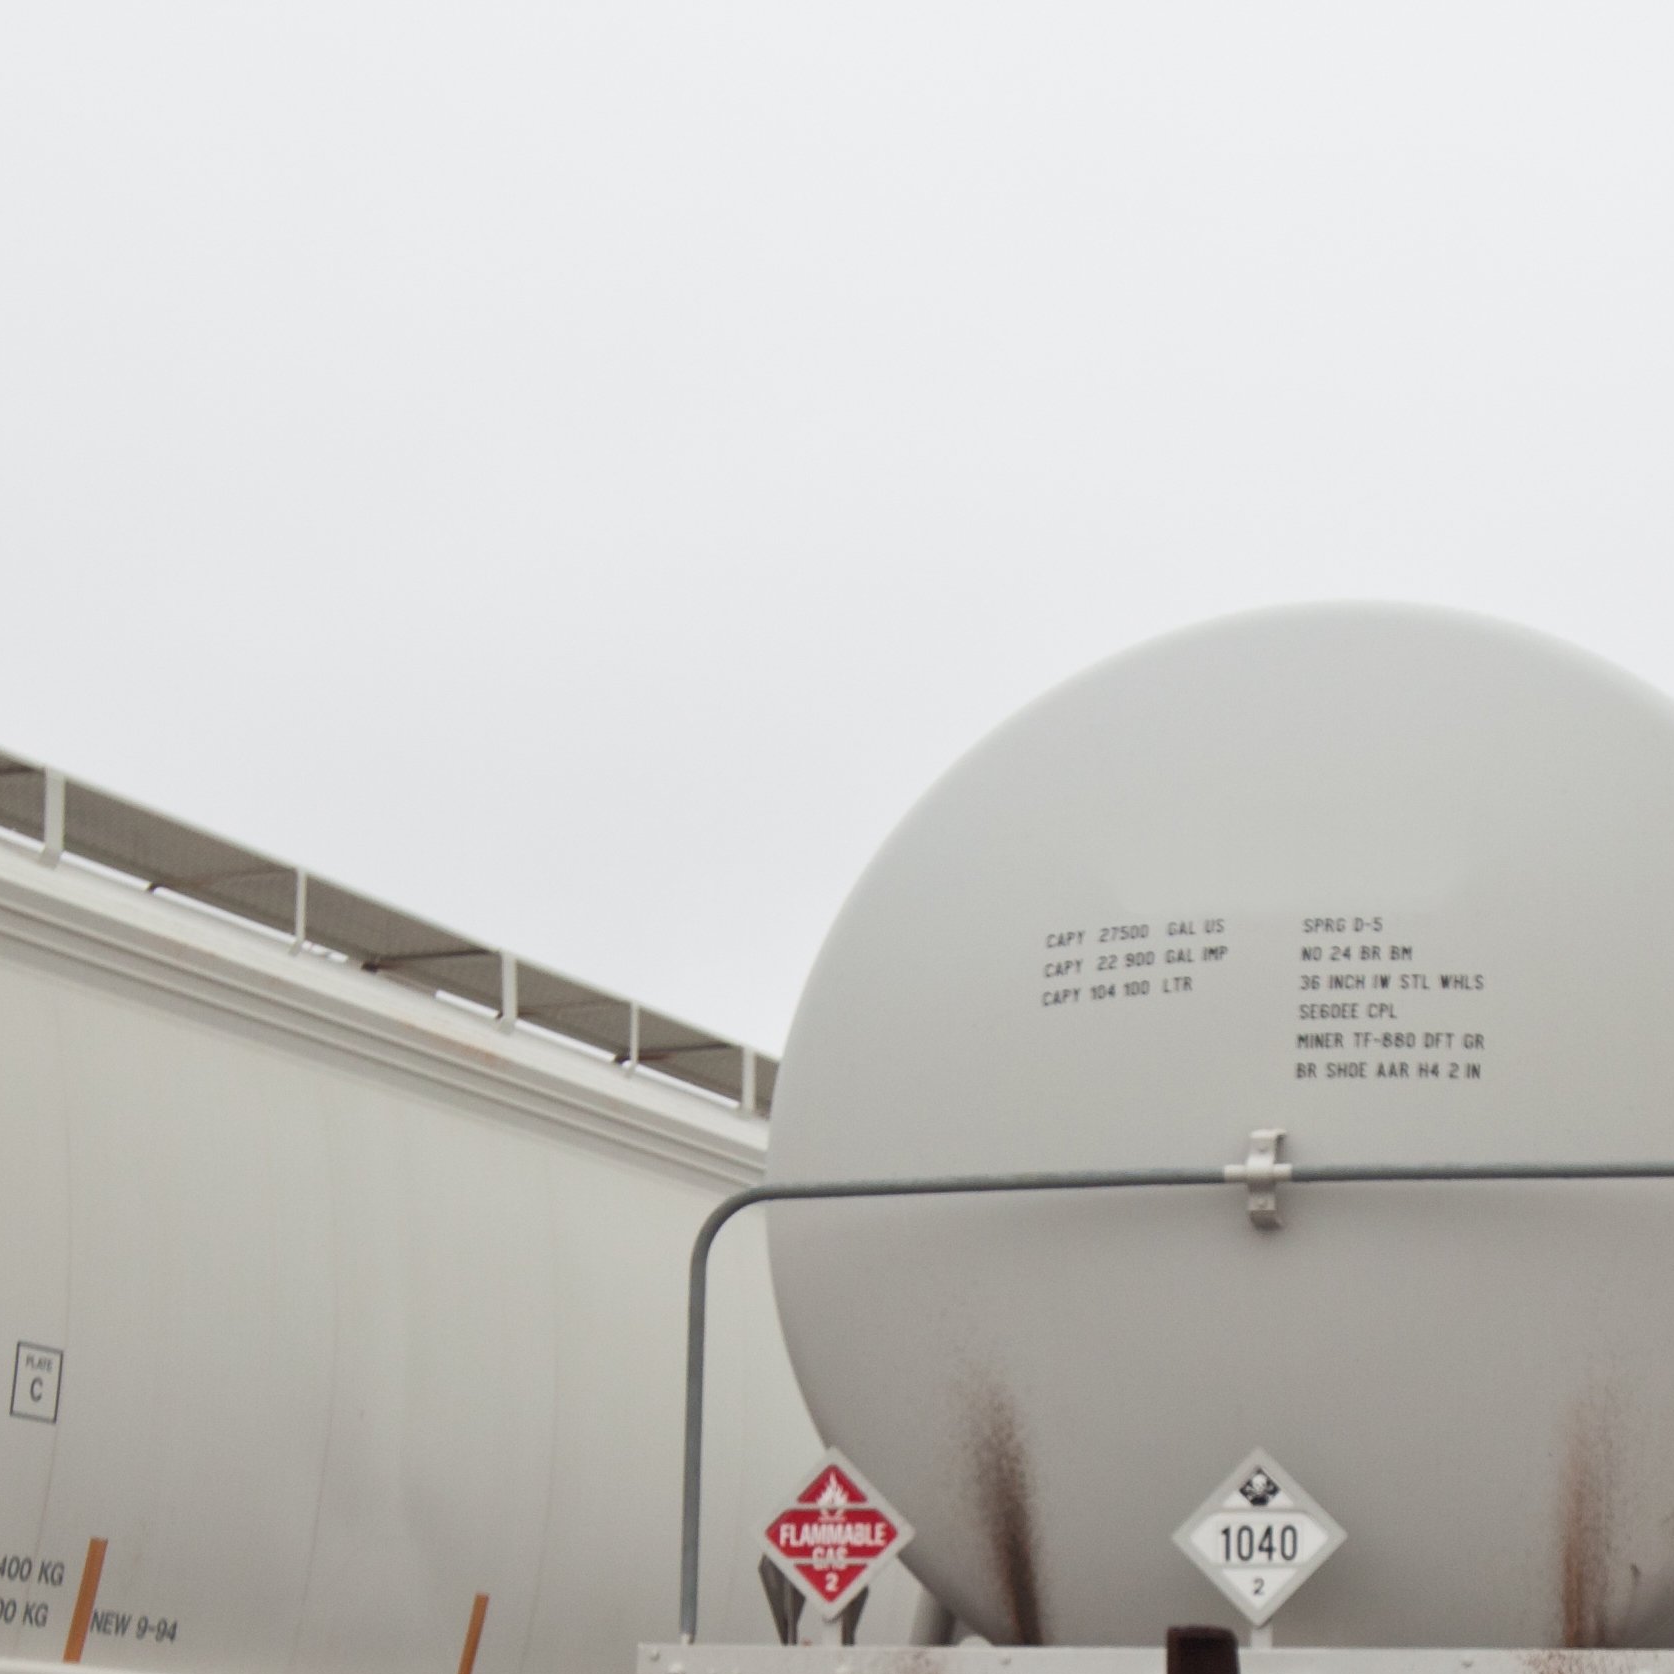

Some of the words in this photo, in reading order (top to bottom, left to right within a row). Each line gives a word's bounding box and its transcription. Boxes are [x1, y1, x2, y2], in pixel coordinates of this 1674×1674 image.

[1046, 931, 1085, 948] CAPY
[1099, 924, 1150, 942] 27500
[1167, 921, 1196, 936] GAL
[1204, 918, 1225, 933] US
[1303, 918, 1346, 933] SPRG
[1353, 917, 1383, 932] D-5
[1044, 959, 1083, 977] CAPY
[1096, 954, 1118, 971] 22
[1124, 951, 1155, 967] 900
[1165, 947, 1195, 963] GAL
[1202, 945, 1229, 961] IMP
[1330, 946, 1351, 961] 24
[1360, 946, 1381, 961] BR
[1390, 945, 1413, 961] BM
[1042, 988, 1082, 1006] CAPY
[1090, 983, 1116, 1000] 104
[1123, 980, 1151, 997] 100
[1162, 976, 1193, 993] LTR
[1300, 974, 1320, 990] 36
[1328, 974, 1366, 990] INCH
[1400, 974, 1430, 990] STL
[1439, 974, 1485, 990] WHLS
[1366, 1003, 1398, 1019] CPL
[1296, 1032, 1344, 1049] MINER
[1423, 1032, 1455, 1048] DFT
[1463, 1033, 1485, 1049] GR
[1296, 1062, 1317, 1079] BR
[1326, 1062, 1367, 1079] SHOE
[1376, 1062, 1410, 1078] AAR
[1418, 1062, 1439, 1078] H4
[1448, 1062, 1460, 1078] 2
[1466, 1062, 1481, 1079] IN
[30, 1376, 43, 1403] C
[779, 1522, 886, 1547] FLAMMABLE
[1221, 1524, 1299, 1563] 1040
[812, 1546, 848, 1571] GAS
[38, 1560, 65, 1587] KG
[825, 1571, 839, 1592] 2
[1252, 1577, 1265, 1597] 2
[23, 1601, 49, 1628] KG
[90, 1608, 132, 1637] NEW
[136, 1615, 179, 1643] 9-94
